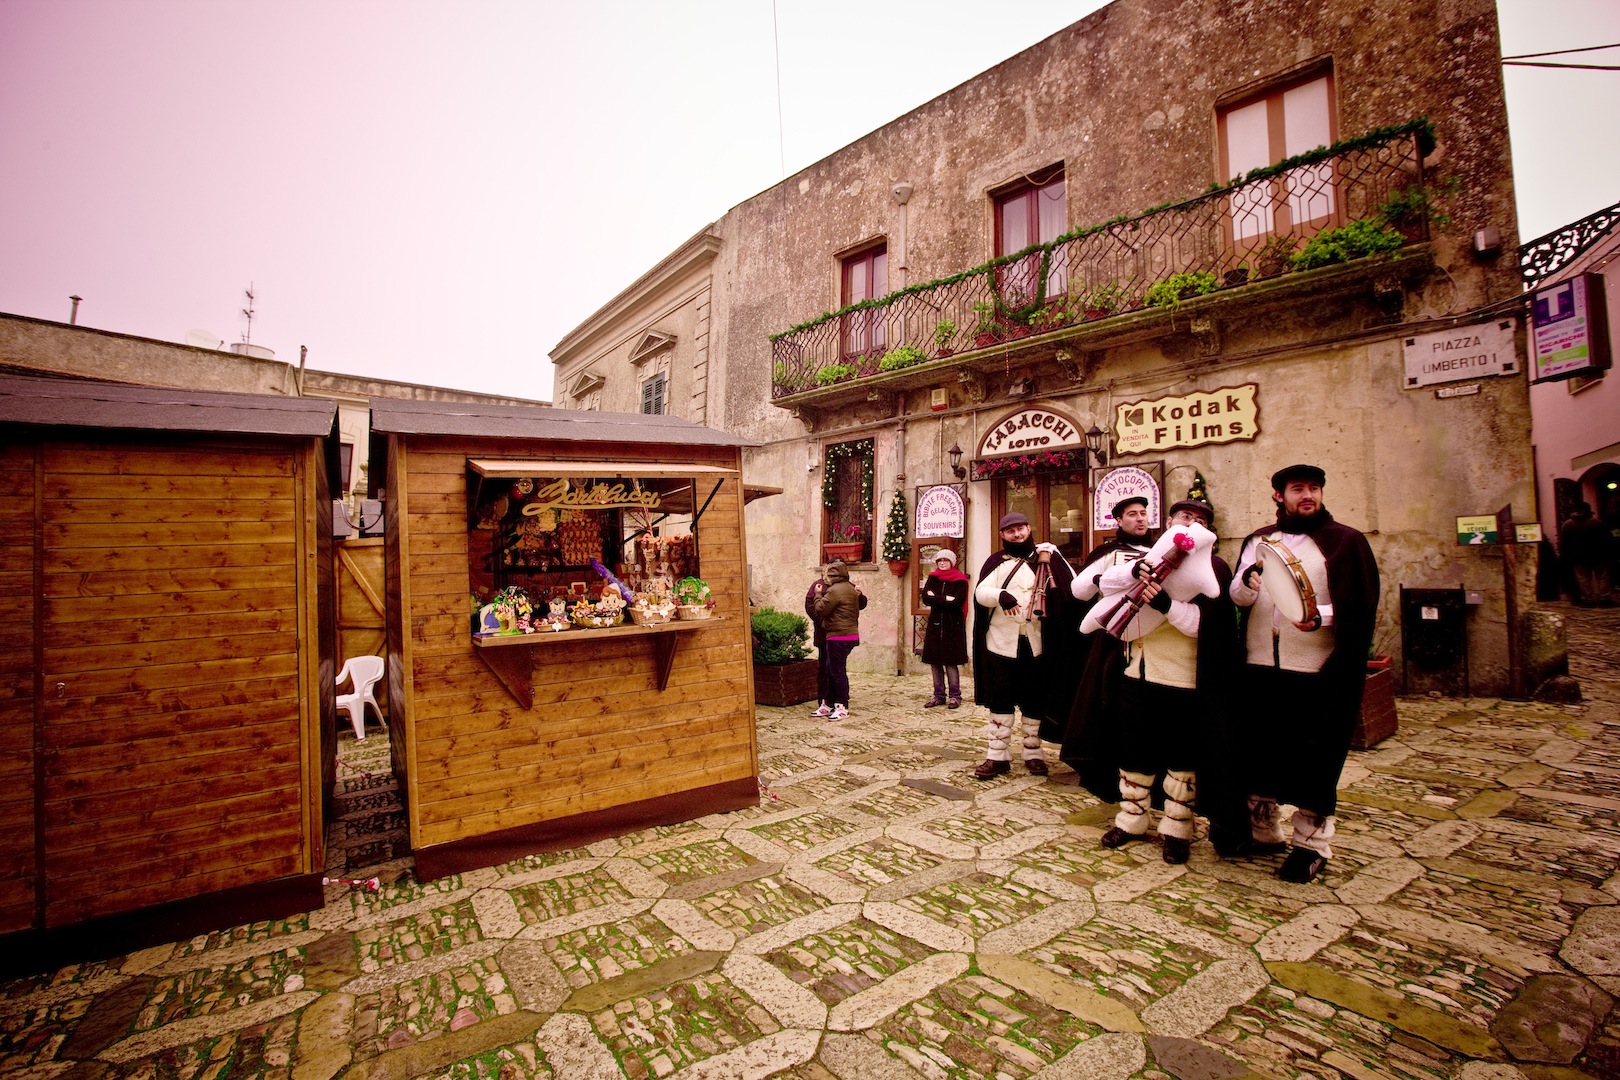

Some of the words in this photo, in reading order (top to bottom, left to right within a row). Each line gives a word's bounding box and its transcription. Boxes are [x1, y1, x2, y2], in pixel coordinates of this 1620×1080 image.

[1536, 282, 1570, 318] T
[1433, 336, 1482, 352] PIAZZA
[1538, 332, 1586, 349] RICARICHE
[1423, 355, 1487, 374] UMBERTO
[1493, 353, 1497, 363] I
[1152, 395, 1241, 423] Kodak
[986, 413, 1074, 450] TABACCHI
[1122, 434, 1149, 442] VENDITA
[1154, 421, 1243, 444] Films
[1008, 436, 1050, 450] LOTTO
[1104, 475, 1149, 495] FOTOCOPIE
[1117, 487, 1135, 496] FAX
[923, 496, 935, 518] BIBITE
[936, 493, 957, 517] FRESCHE
[930, 507, 950, 516] GELATI
[923, 521, 957, 530] SOUVENIRS
